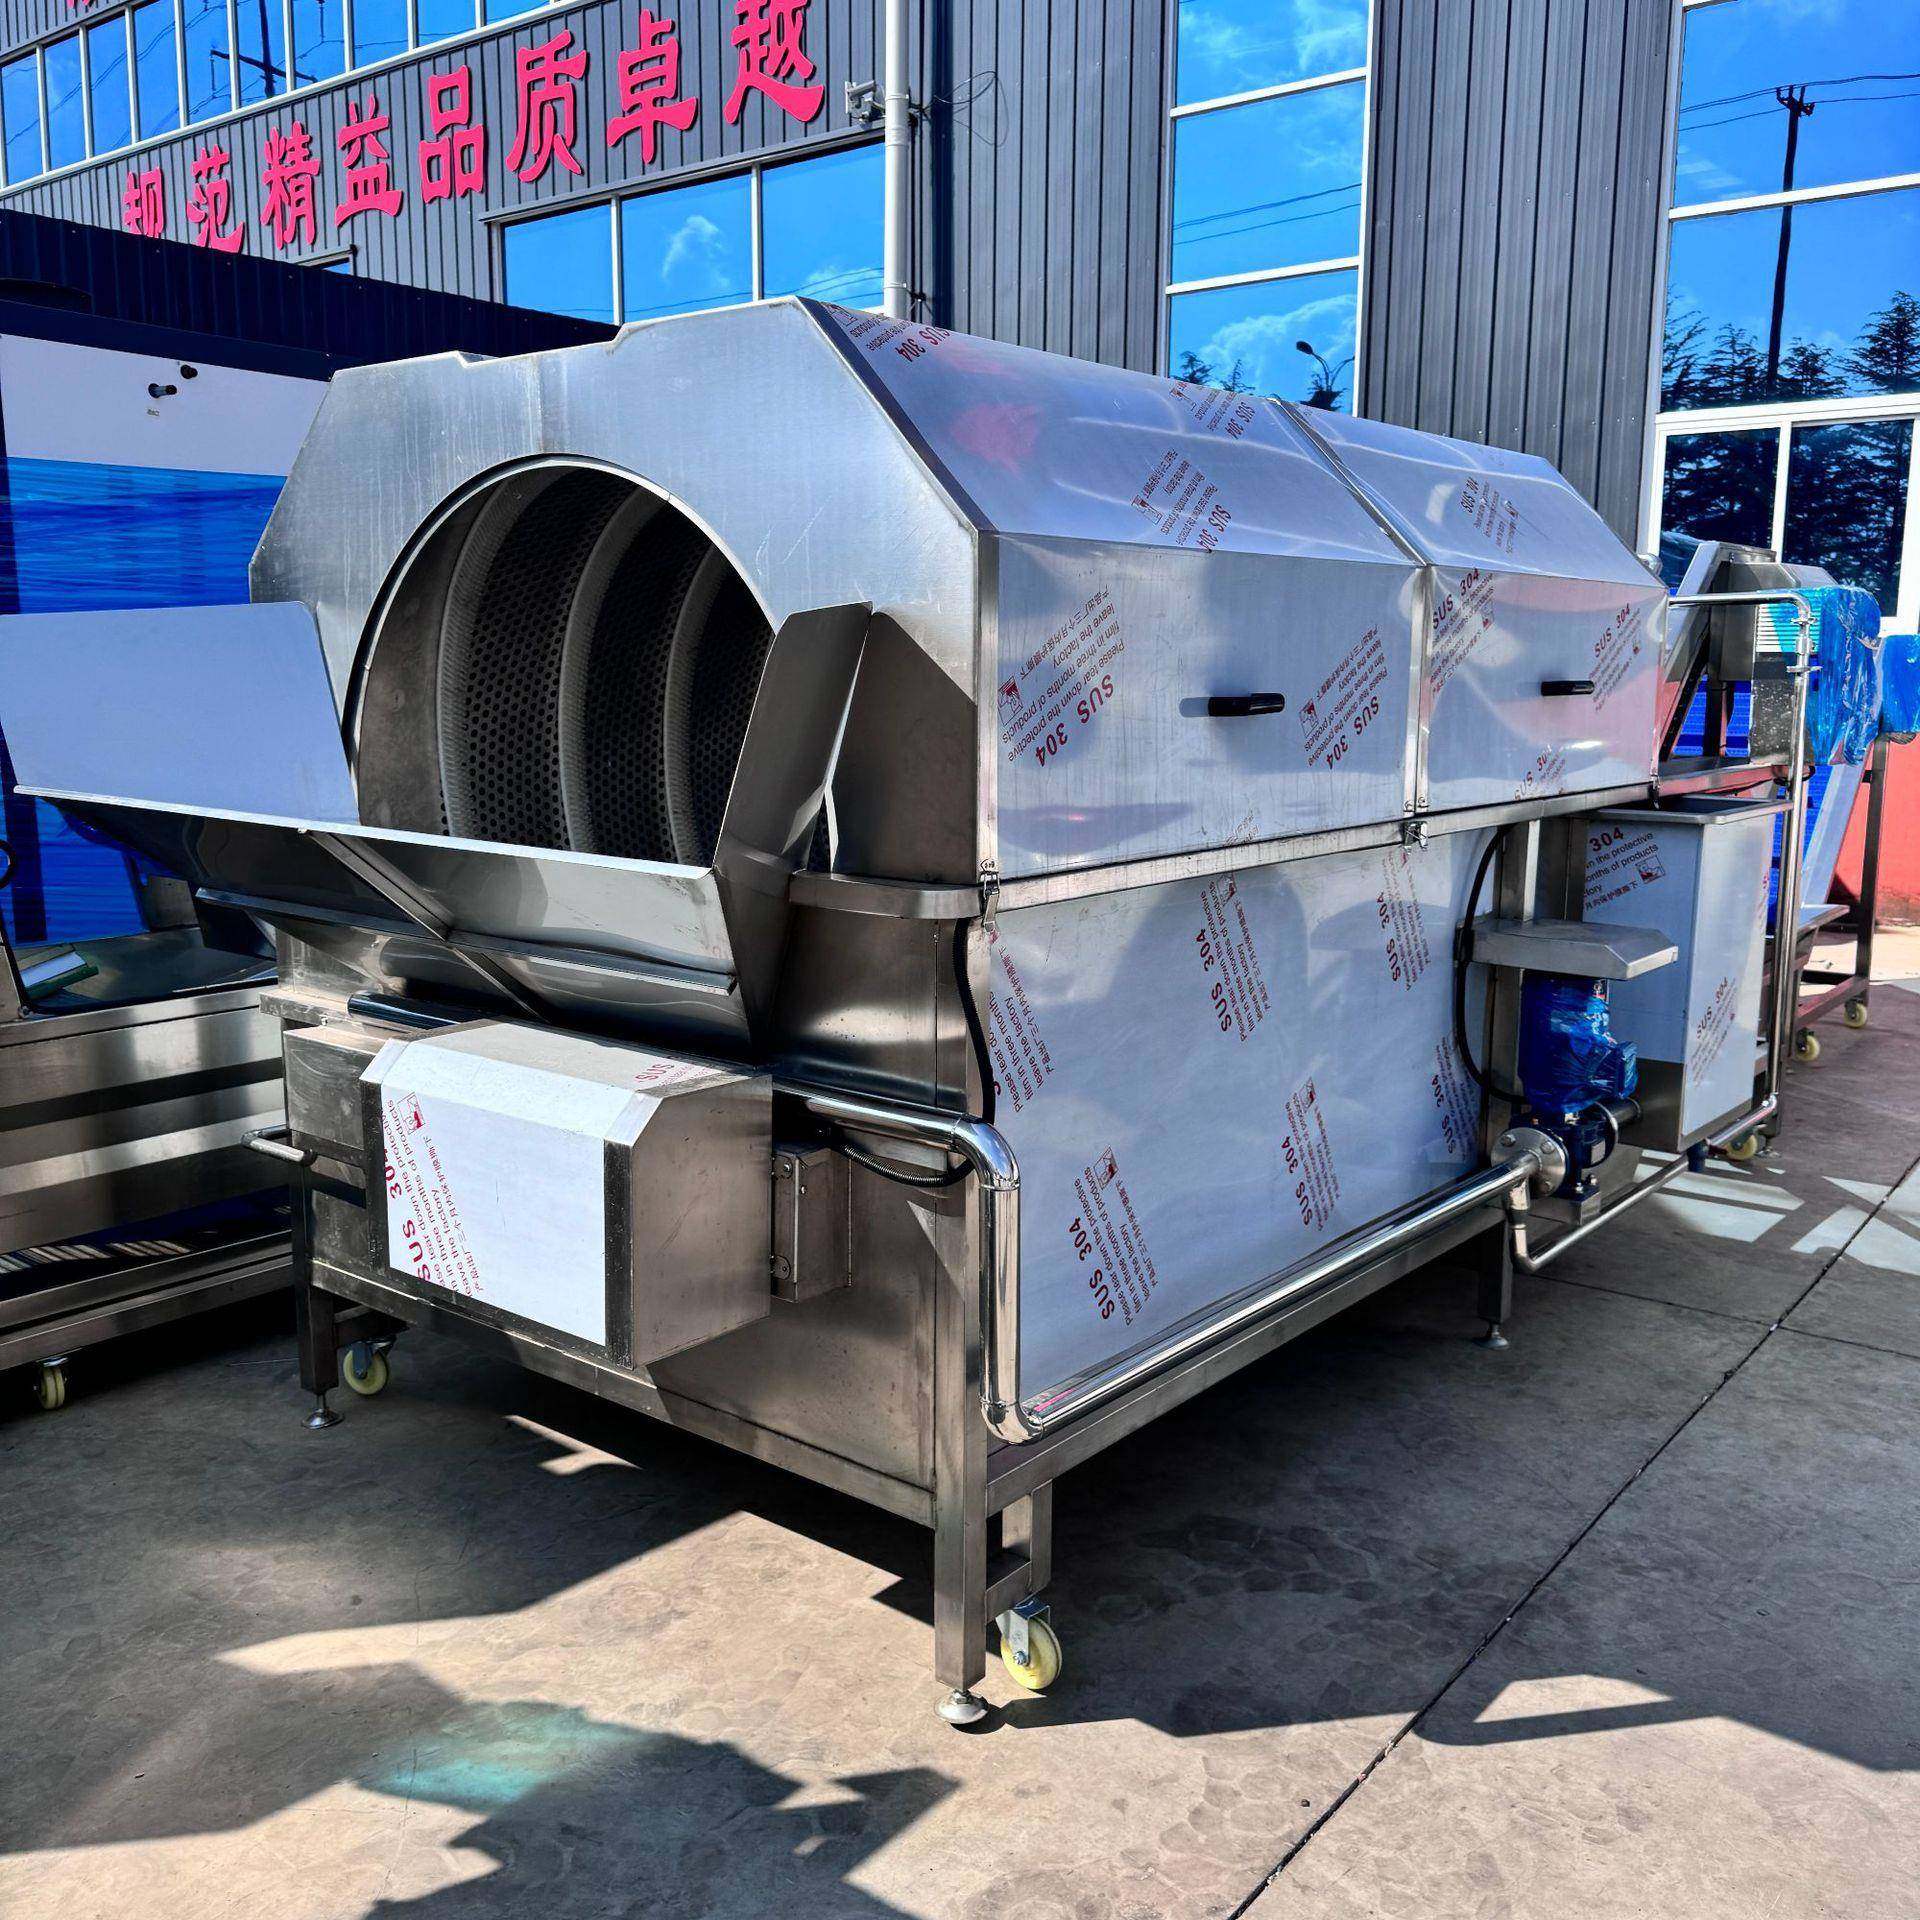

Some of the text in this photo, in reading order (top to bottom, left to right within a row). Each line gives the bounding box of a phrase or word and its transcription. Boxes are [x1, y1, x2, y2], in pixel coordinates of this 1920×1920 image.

[895, 338, 926, 362] 304
[1225, 402, 1255, 439] SUS 304
[1208, 504, 1231, 532] SUS
[1459, 490, 1475, 513] SUS
[1433, 594, 1453, 630] SUS
[1595, 627, 1612, 658] SUS
[1616, 603, 1630, 629] 304
[1053, 603, 1115, 669] leave the factory
[1002, 620, 1120, 744] film in three months of products
[1008, 638, 1125, 762] Please tear down the protective
[1035, 674, 1113, 766] SUS 304
[1326, 696, 1379, 769] SUS 304
[1589, 827, 1624, 852] 304
[1376, 892, 1390, 929] 304
[1386, 938, 1401, 982] SUS
[1196, 929, 1232, 1032] SUS 304
[1697, 1006, 1712, 1039] SUS
[1716, 977, 1728, 1004] 304
[994, 1049, 1007, 1074] tear
[1004, 997, 1044, 1088] leave the factory
[1005, 1035, 1020, 1067] three
[634, 1064, 675, 1083] SUS
[1017, 1065, 1025, 1080] in
[1022, 1077, 1034, 1101] film
[1431, 1074, 1444, 1108] 304
[1005, 1072, 1024, 1113] Please
[1441, 1115, 1455, 1154] SUS
[1281, 1136, 1298, 1174] 304
[388, 1100, 454, 1276] in three months of products
[402, 1171, 412, 1193] the
[410, 1195, 426, 1231] down
[431, 1189, 450, 1234] factory
[1295, 1181, 1313, 1225] SUS
[402, 1219, 430, 1279] SUS
[423, 1235, 436, 1260] tear
[449, 1237, 459, 1259] the
[1069, 1217, 1115, 1320] SUS 304
